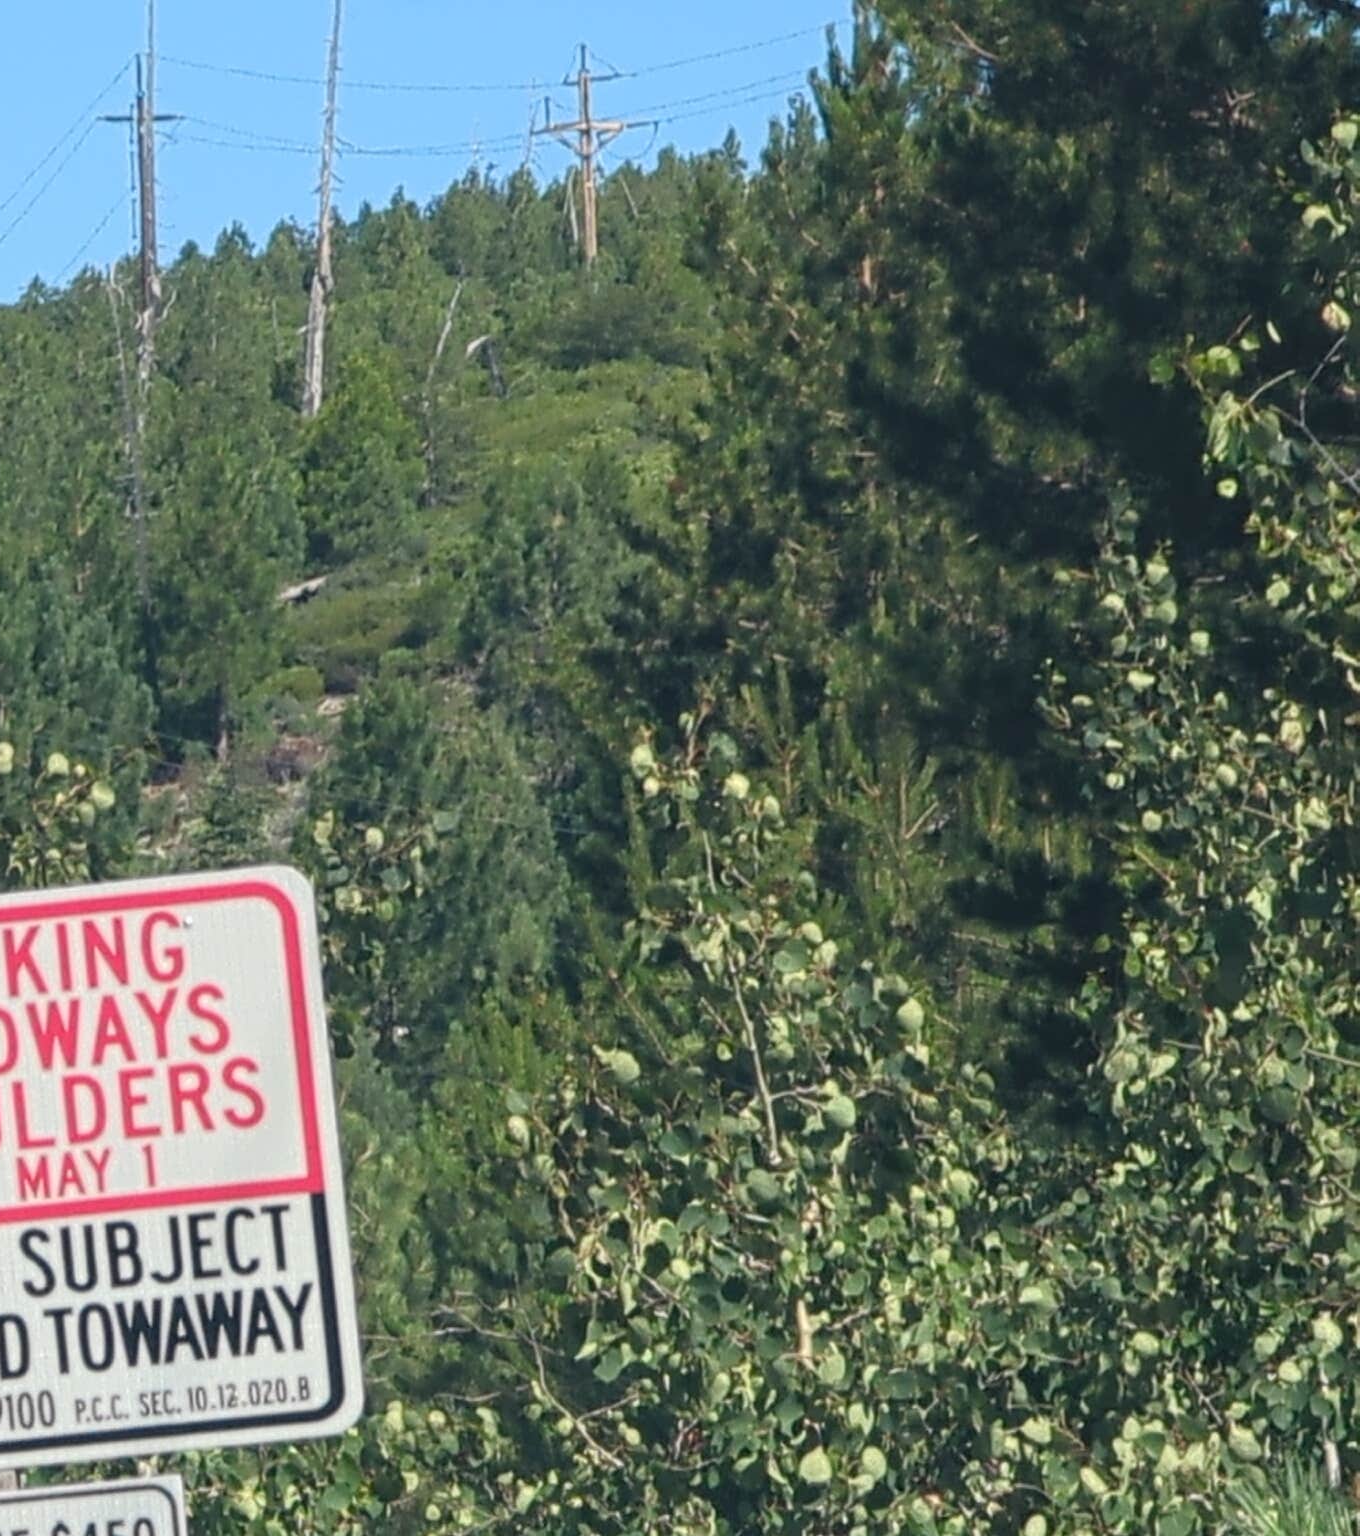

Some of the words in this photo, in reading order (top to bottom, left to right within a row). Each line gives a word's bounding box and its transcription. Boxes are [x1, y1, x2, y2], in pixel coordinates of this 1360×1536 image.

[17, 1148, 110, 1201] MAY
[142, 1143, 156, 1188] 1
[19, 1204, 290, 1304] SUBJECT
[43, 1282, 313, 1374] TOWAWAY
